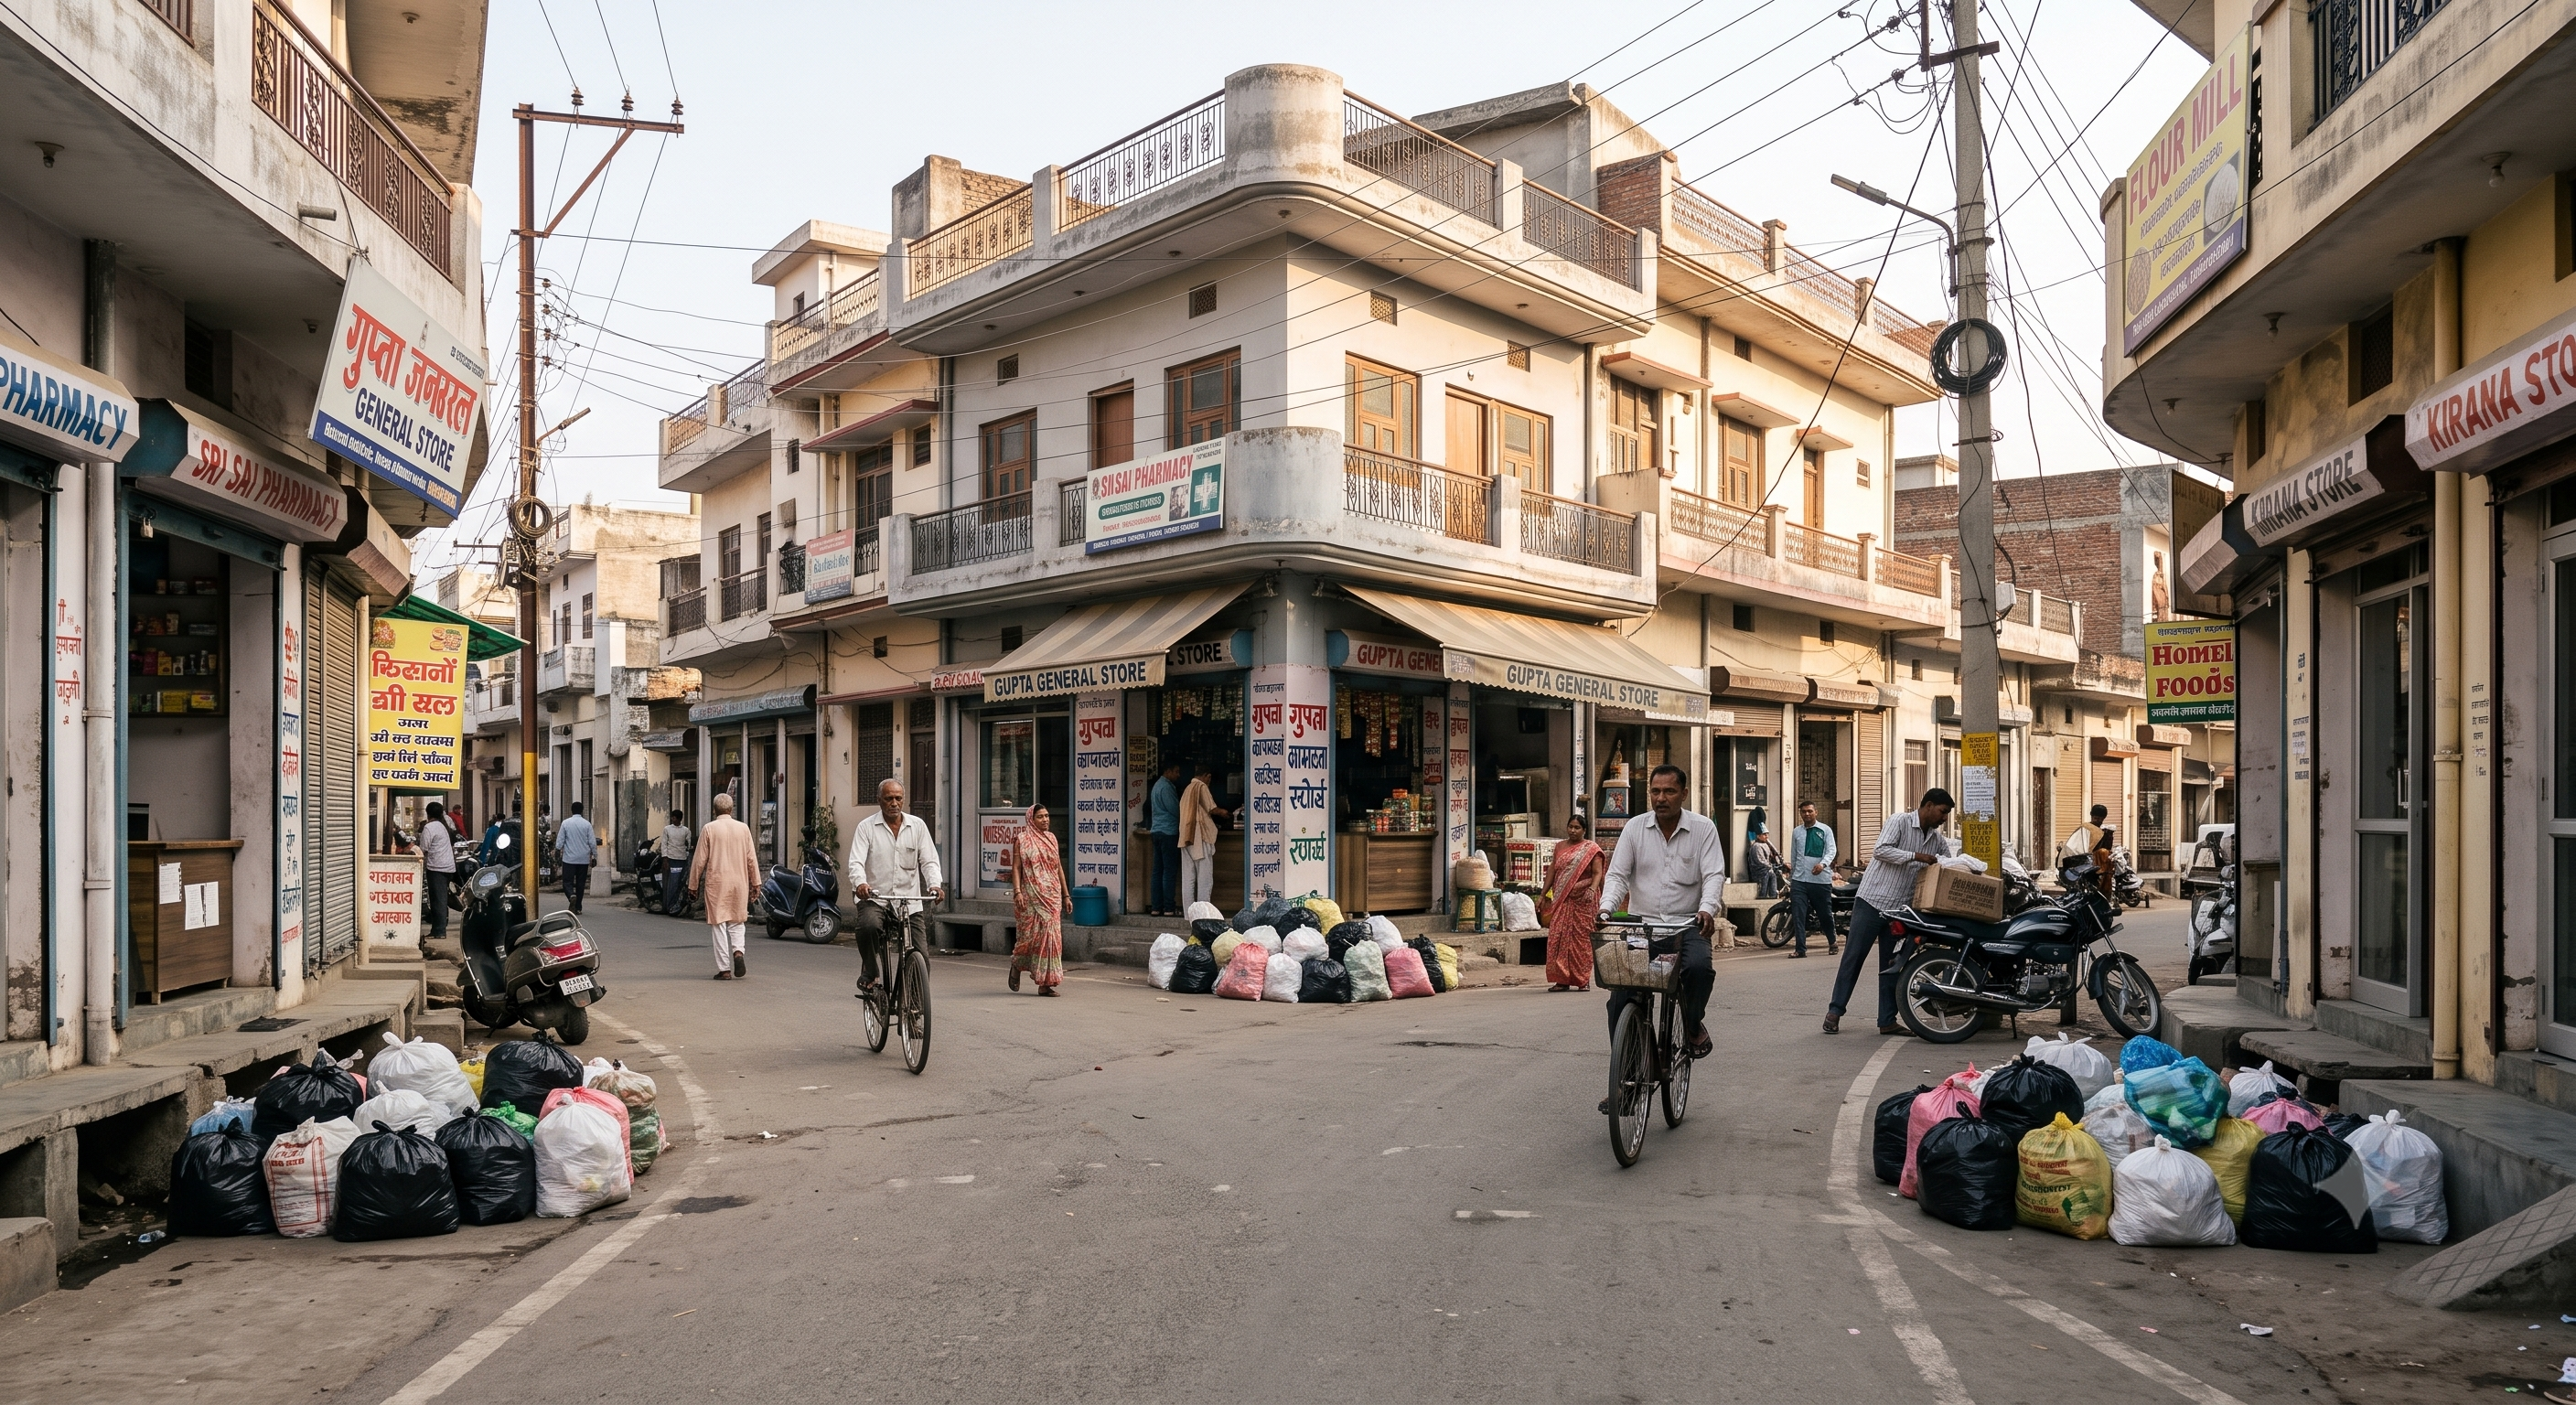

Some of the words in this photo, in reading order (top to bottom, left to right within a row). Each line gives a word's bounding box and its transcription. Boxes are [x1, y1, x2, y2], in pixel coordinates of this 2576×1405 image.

[2130, 115, 2185, 226] FLOUR
[2191, 52, 2241, 155] MILL
[356, 388, 413, 449] GENERAL
[416, 425, 456, 473] STORE
[2427, 367, 2523, 452] KIRANA
[192, 440, 228, 486] SRI
[225, 455, 259, 499] SAI
[253, 467, 339, 532] PHARMACY
[1134, 454, 1194, 490] PHARMACY
[2305, 450, 2363, 511] STORE
[994, 674, 1034, 696] GUPTA
[1036, 667, 1098, 692] GENERAL
[1100, 661, 1146, 685] STORE
[1177, 642, 1223, 666] STORE
[1357, 644, 1404, 669] GUPTA
[1507, 664, 1551, 690] GUPTA
[1555, 673, 1615, 701] GENERAL
[1618, 685, 1658, 708] STORE
